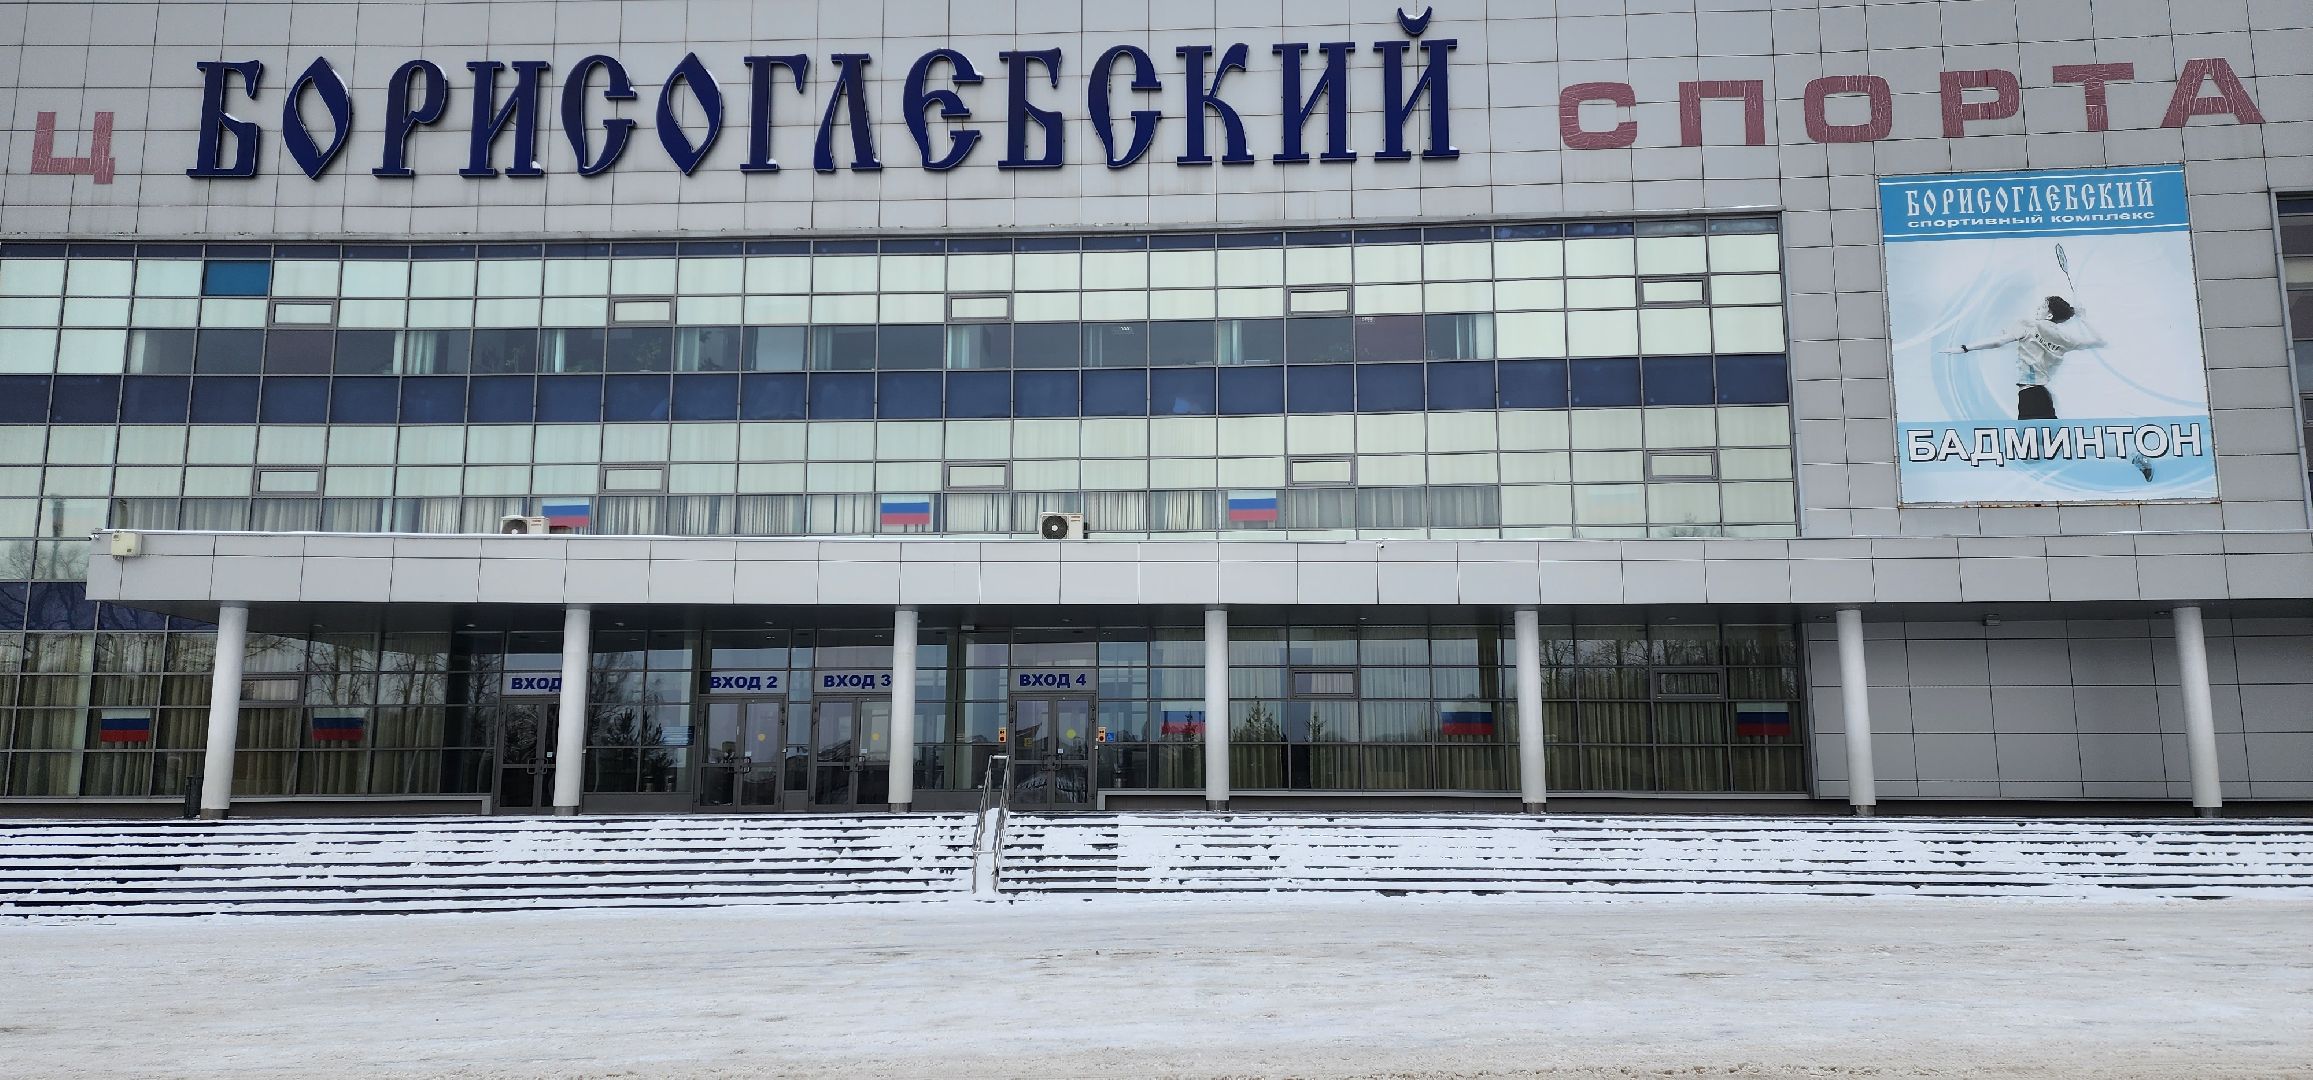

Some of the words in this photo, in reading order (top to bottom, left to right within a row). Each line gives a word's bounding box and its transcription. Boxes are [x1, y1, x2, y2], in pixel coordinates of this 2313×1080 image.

[186, 6, 1460, 180] БОРИСОГЛЕБСКИЙ
[1558, 57, 2265, 150] СПОРТА
[1905, 179, 2155, 217] БОРИСОГЛЕБСКИЙ
[1907, 214, 2044, 229] спортивный
[2050, 211, 2156, 223] комплекс
[1907, 423, 2203, 467] БАДМИНТОН
[511, 677, 562, 692] ВХОД
[710, 676, 761, 690] ВХОД
[766, 675, 778, 689] 2
[823, 674, 876, 690] ВХОД
[880, 673, 892, 687] 3
[1019, 673, 1071, 689] ВХОД
[1075, 673, 1087, 686] 4
